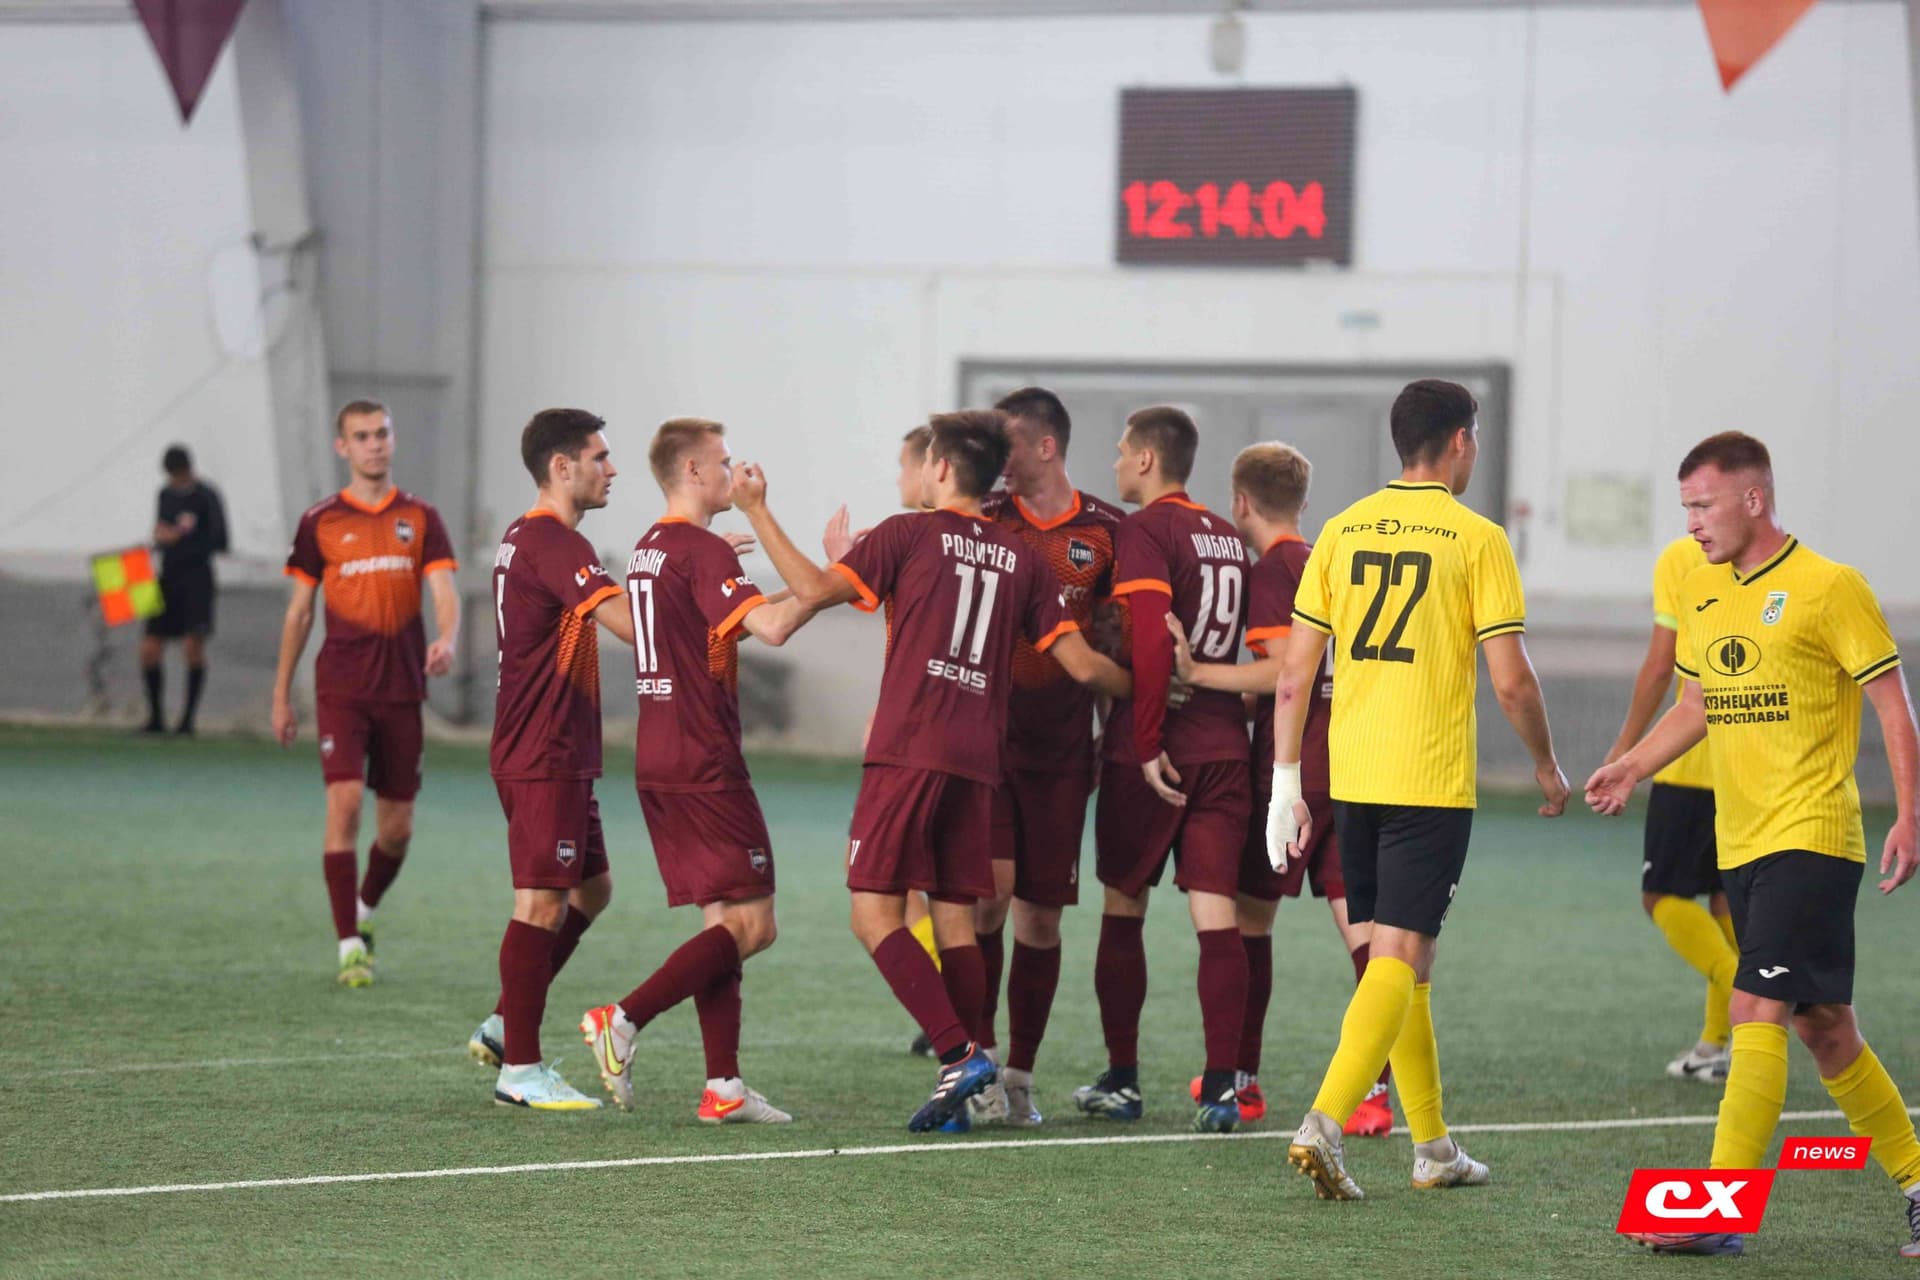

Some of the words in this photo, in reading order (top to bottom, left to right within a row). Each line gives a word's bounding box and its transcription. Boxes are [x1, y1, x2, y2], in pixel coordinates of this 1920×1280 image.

[1123, 180, 1327, 238] 12:14:04
[1191, 533, 1243, 561] ШИБАЕВ
[1342, 524, 1372, 534] АСР
[1403, 525, 1457, 540] ГРУПП
[941, 533, 1016, 573] РОДИЧЕВ
[950, 562, 999, 665] 11
[1189, 564, 1242, 658] 19
[1351, 550, 1432, 664] 22
[636, 678, 672, 694] SEUS
[927, 659, 987, 689] SEUS
